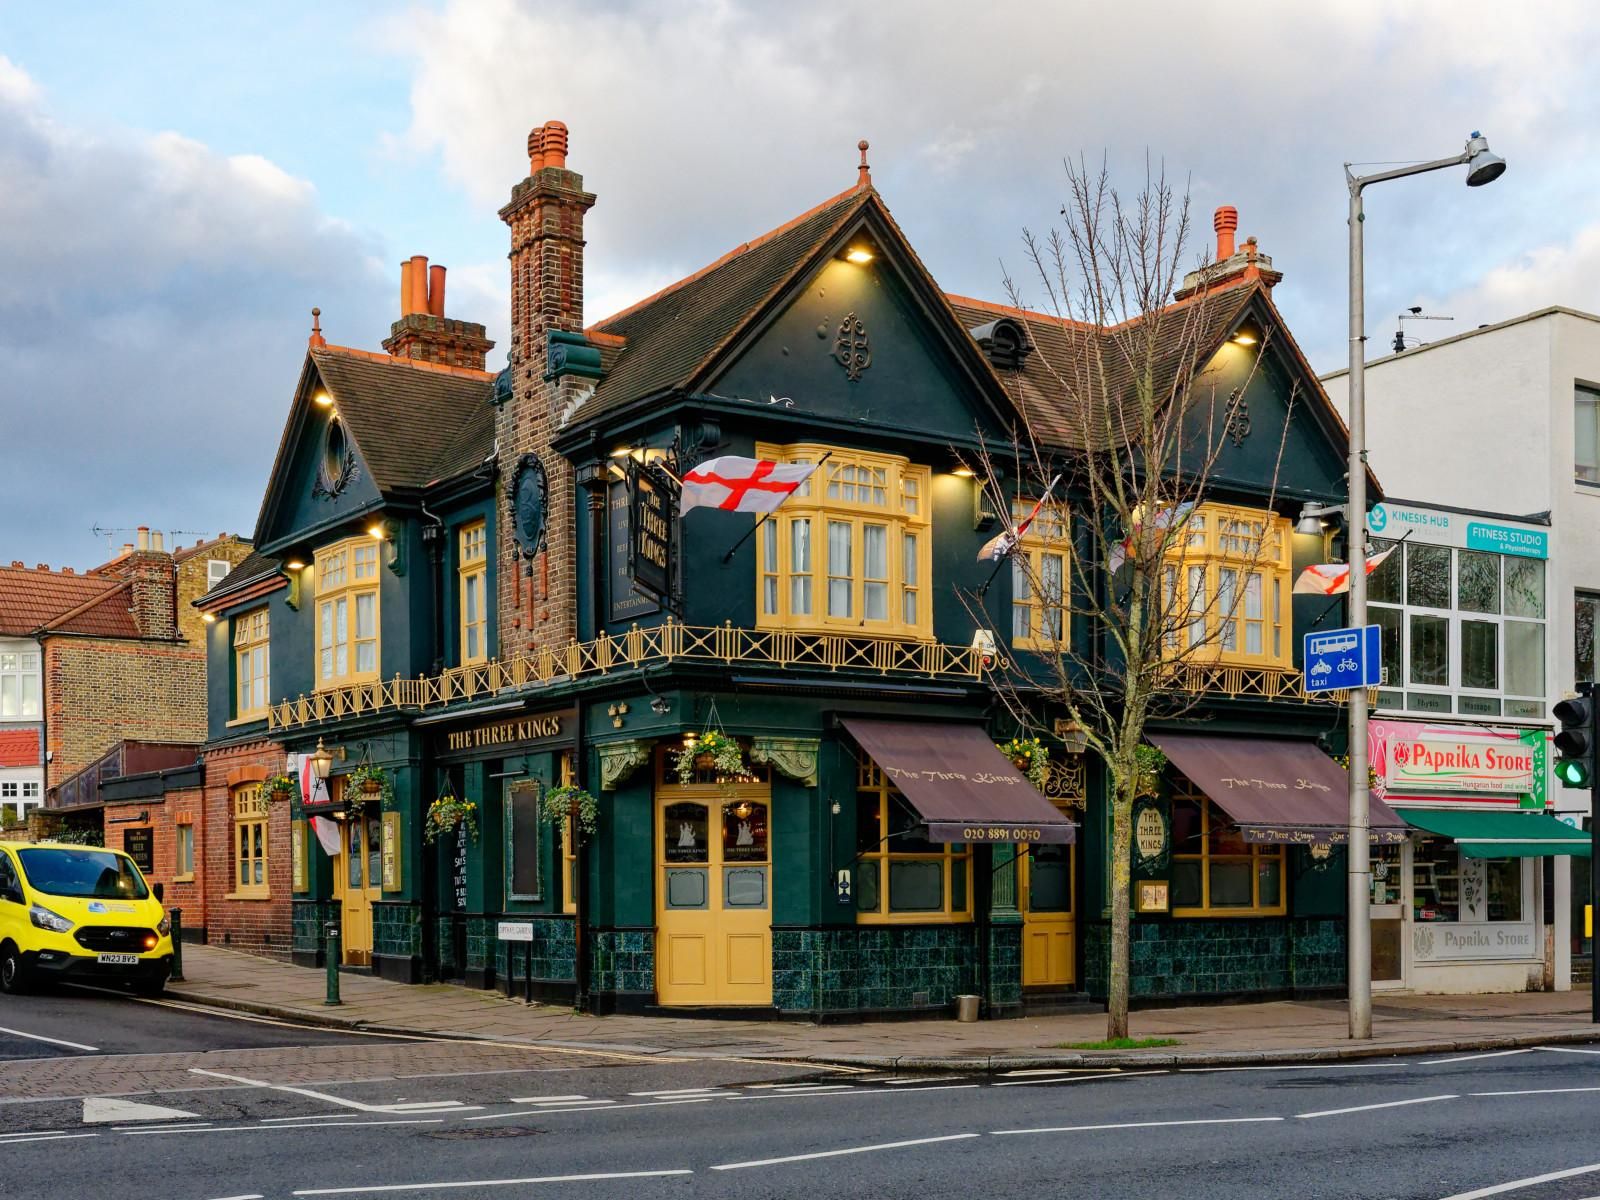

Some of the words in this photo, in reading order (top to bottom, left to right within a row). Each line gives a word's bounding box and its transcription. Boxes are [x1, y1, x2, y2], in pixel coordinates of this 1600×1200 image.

[1392, 511, 1427, 524] KINESIS
[1430, 516, 1449, 528] HUB
[1472, 527, 1508, 541] FITNESS
[1510, 532, 1542, 546] STUDIO
[1500, 542, 1504, 550] &
[1505, 543, 1541, 555] Physiotherapy
[1311, 677, 1328, 687] taxi
[448, 731, 472, 750] THE
[473, 724, 515, 747] THREE
[518, 716, 560, 740] KINGS
[886, 767, 919, 778] The
[921, 771, 967, 782] Three
[971, 772, 1021, 785] Kings
[1462, 781, 1489, 792] Hungarian
[1490, 782, 1503, 790] food
[1144, 813, 1158, 823] THE
[964, 828, 984, 840] 020
[988, 829, 1009, 841] 8891
[1140, 826, 1162, 836] THREE
[1249, 830, 1265, 840] The
[1267, 830, 1288, 840] Three
[1289, 831, 1315, 843] Kings
[1140, 840, 1162, 849] KINGS
